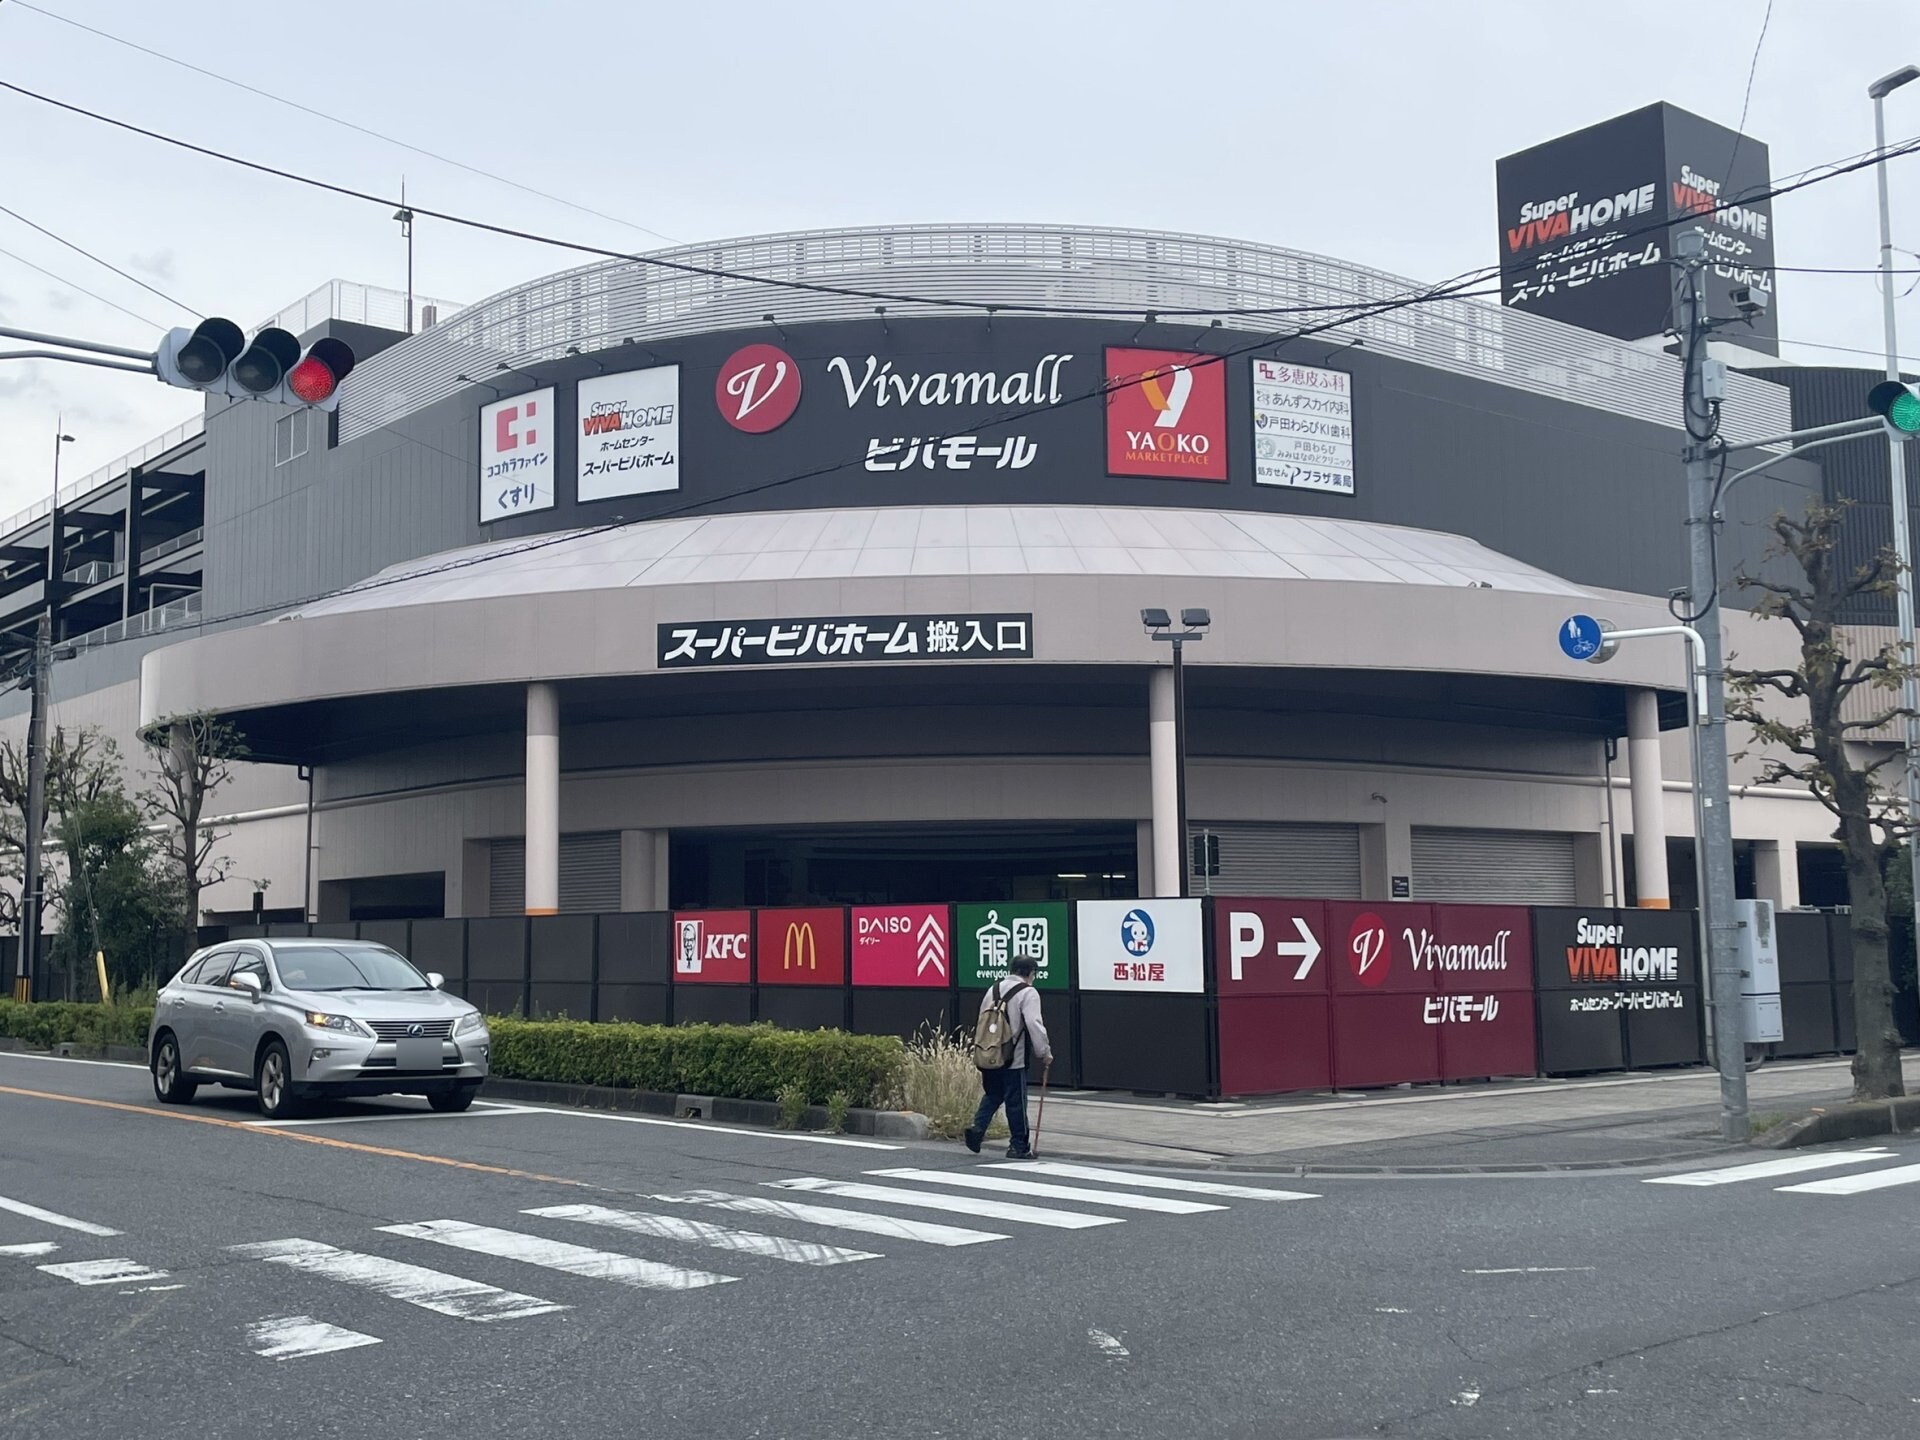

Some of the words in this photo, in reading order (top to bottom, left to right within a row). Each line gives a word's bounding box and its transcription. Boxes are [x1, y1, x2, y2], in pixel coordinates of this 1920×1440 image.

[1681, 165, 1720, 196] Super
[1520, 191, 1578, 223] Super
[1508, 242, 1661, 305] スーパービバホーム
[827, 354, 1074, 409] Vivamall
[1278, 366, 1344, 392] 多恵皮ふ科
[591, 400, 627, 418] Super
[1272, 393, 1349, 415] あんずスカイ内科
[1269, 415, 1350, 440] 戸田わらびKI歯科
[601, 436, 654, 452] ホームセンター
[865, 435, 1038, 472] ビバモール
[1126, 431, 1209, 454] YAOKO
[1294, 441, 1336, 455] 戸田わらび
[488, 453, 548, 478] ココカラファイン
[583, 451, 674, 477] スーパービバホーム
[1126, 451, 1209, 465] MARKETPLACE
[499, 483, 535, 509] くすり
[664, 622, 918, 661] スーパービバホーム
[926, 620, 1026, 653] 搬入口
[859, 917, 911, 933] DAISO
[1577, 918, 1624, 949] Super
[705, 934, 748, 959] KFC
[860, 937, 880, 945] ダイソー
[1230, 912, 1264, 980] P
[1403, 928, 1511, 971] Vivamall
[977, 969, 1011, 981] everyda
[1113, 963, 1164, 981] 西松屋
[1423, 995, 1498, 1024] ビバモール
